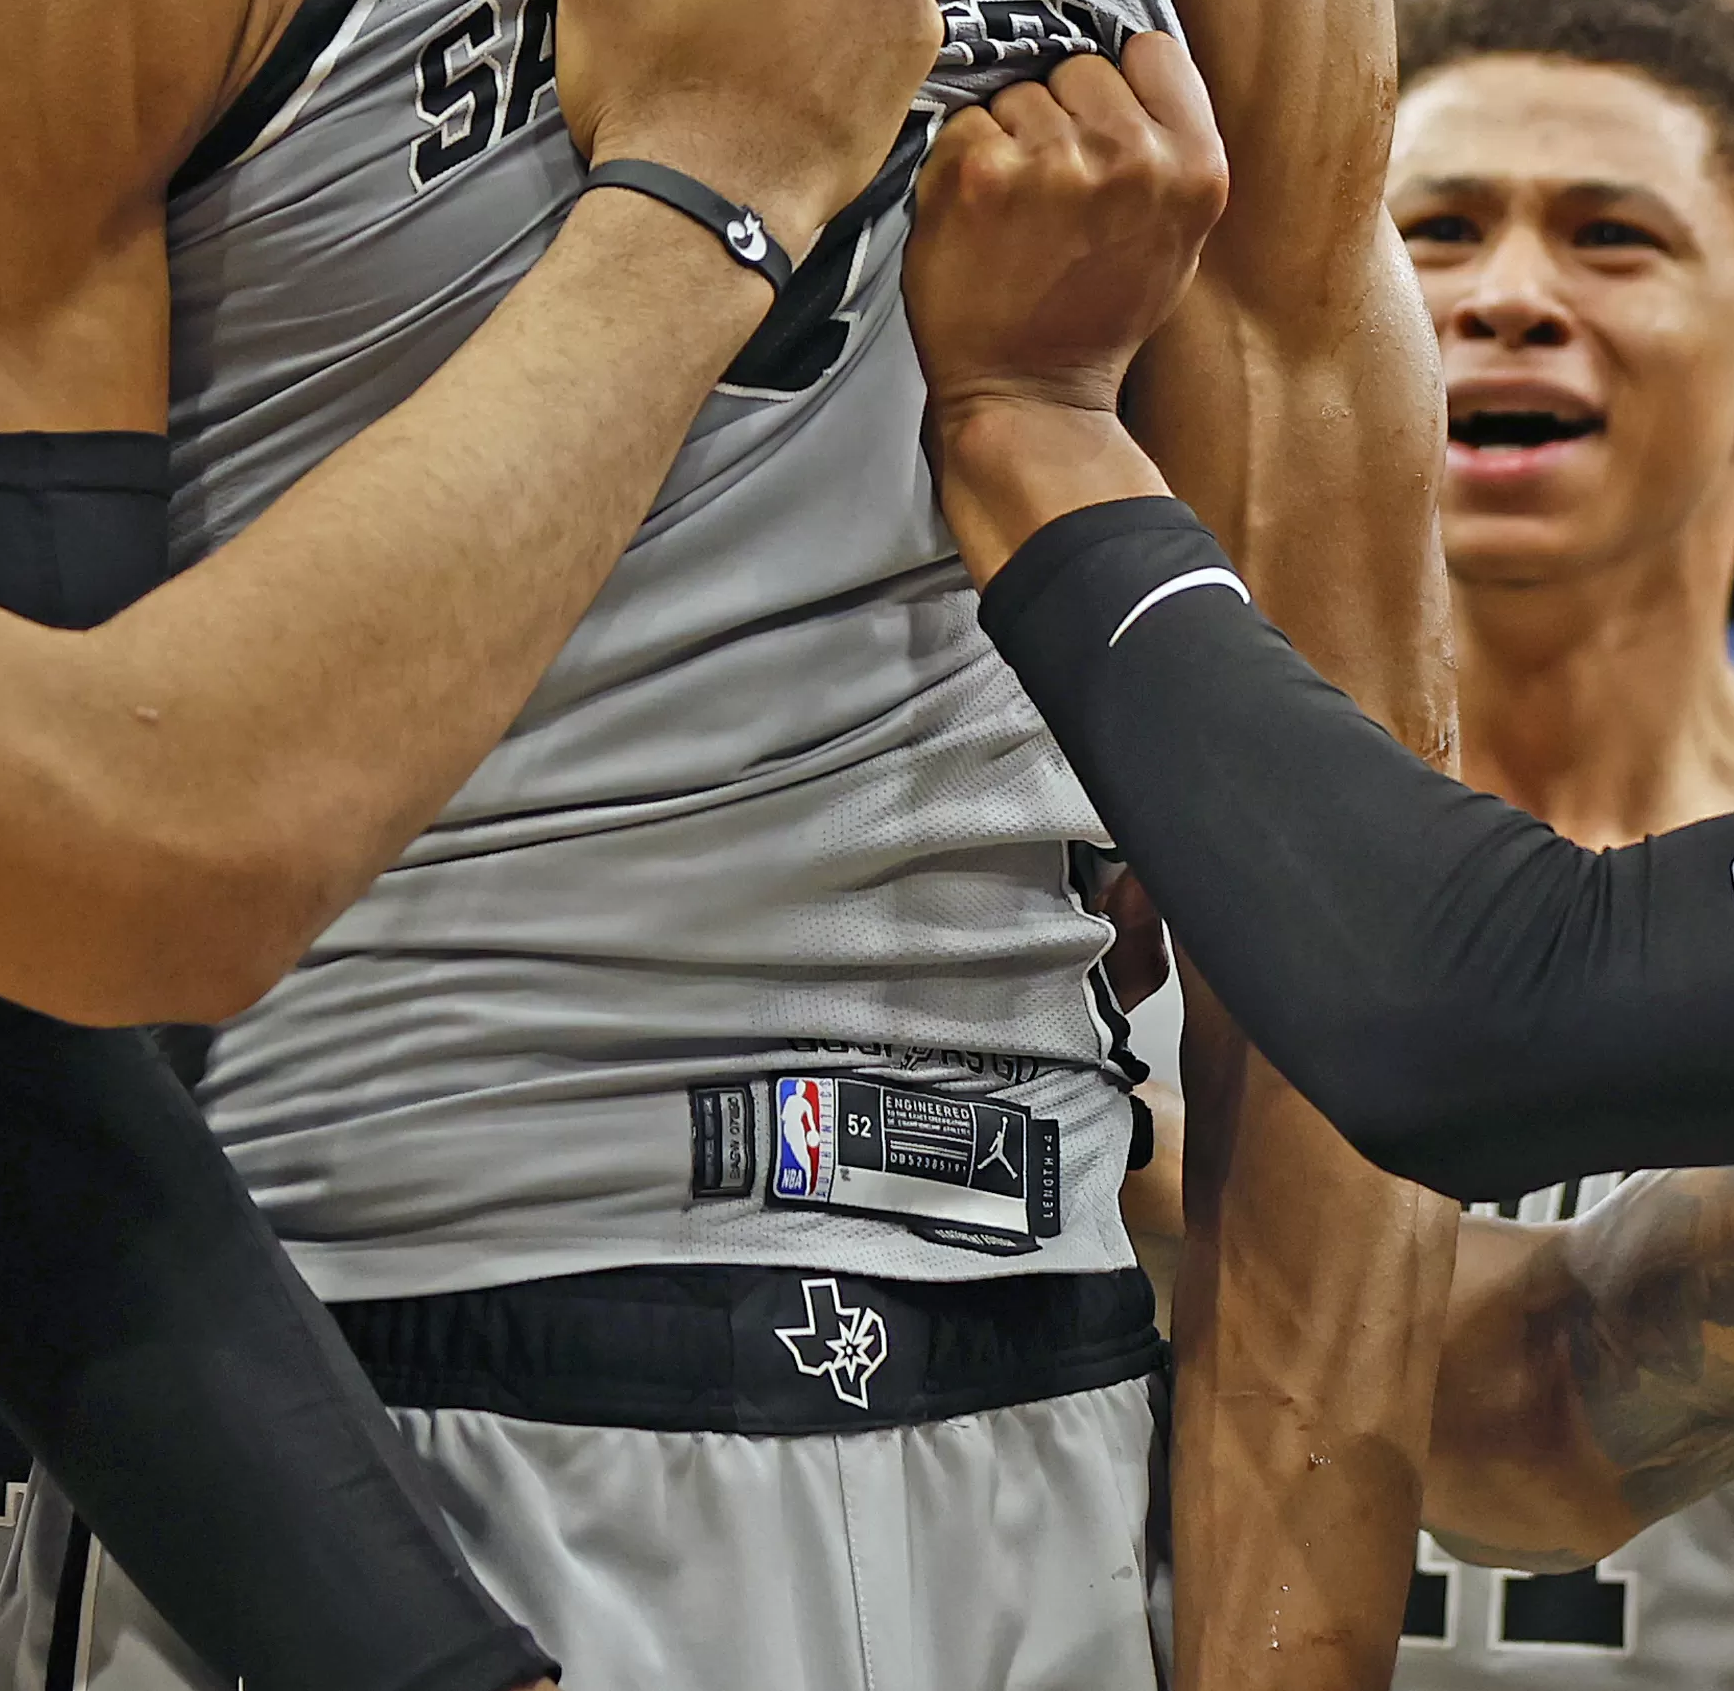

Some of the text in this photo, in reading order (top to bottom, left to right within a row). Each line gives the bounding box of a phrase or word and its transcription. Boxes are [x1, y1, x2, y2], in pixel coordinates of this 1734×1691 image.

[884, 1095, 970, 1120] ENGINEERED
[847, 1113, 873, 1138] 52
[781, 1168, 803, 1191] NBA
